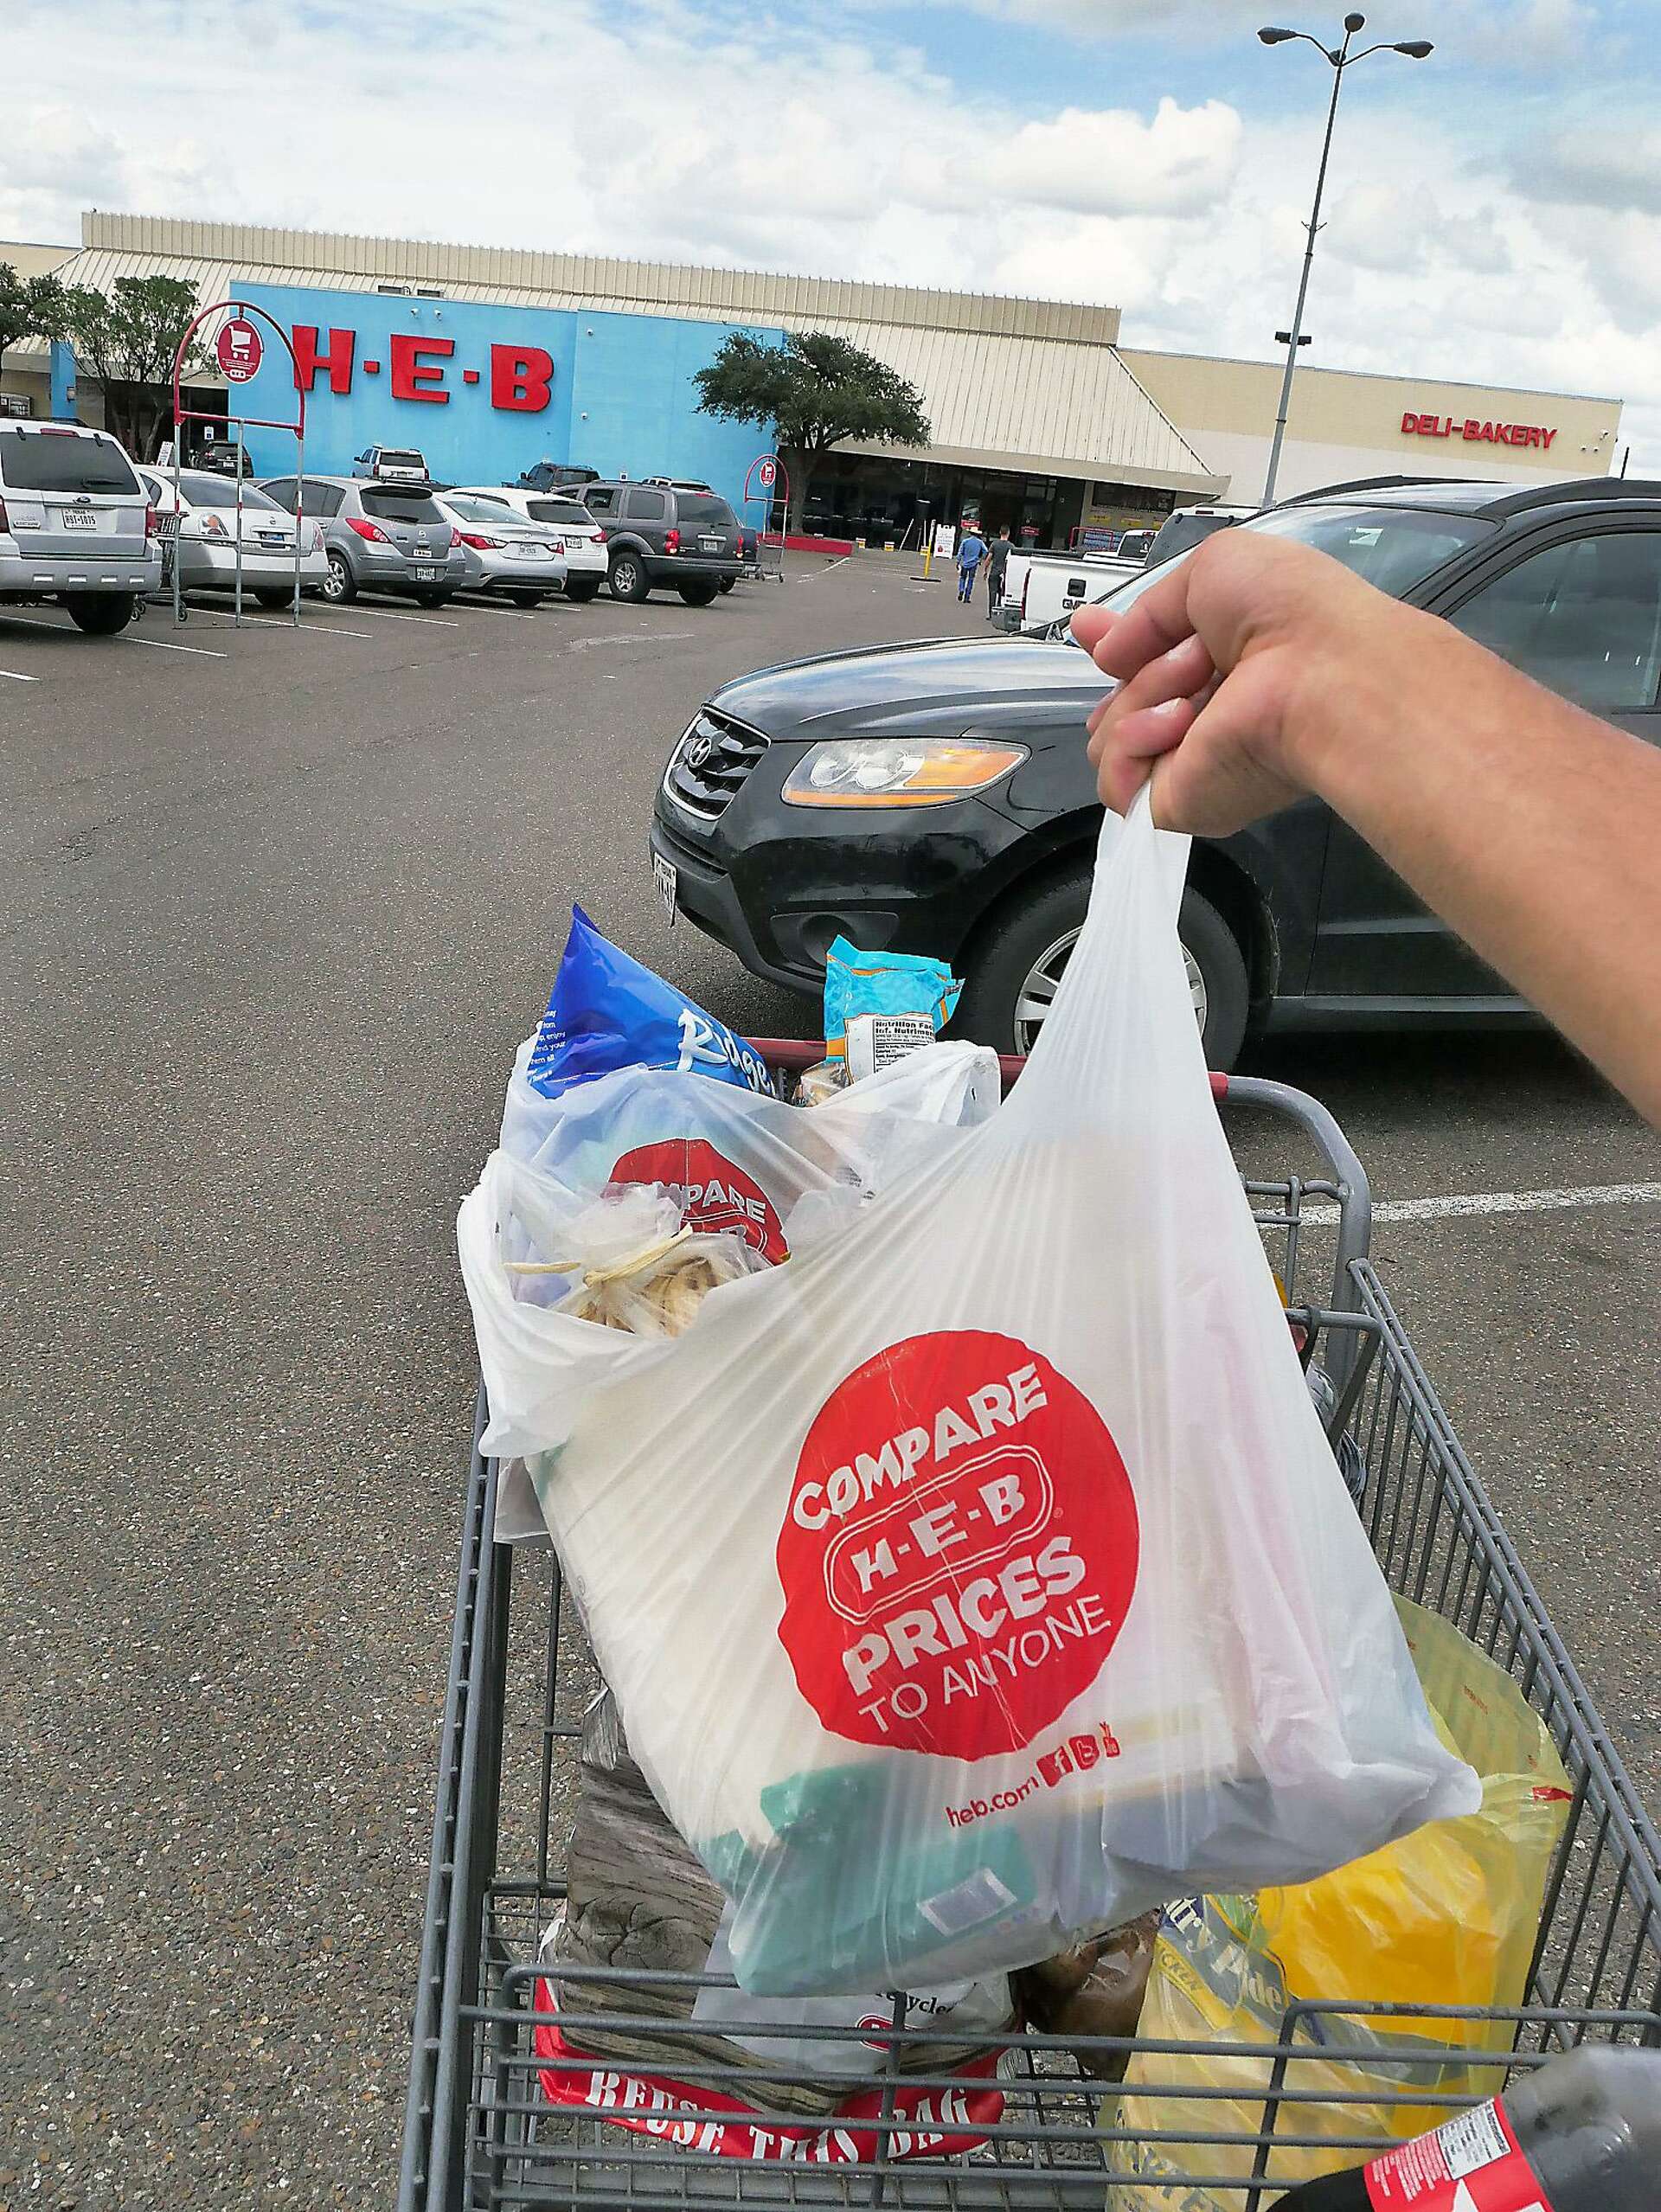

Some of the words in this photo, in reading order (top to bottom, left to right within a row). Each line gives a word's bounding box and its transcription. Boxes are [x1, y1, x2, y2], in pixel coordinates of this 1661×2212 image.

[1401, 412, 1558, 449] DELI-BAKERY
[793, 1362, 1048, 1530] COMPARE
[850, 1474, 1025, 1593] H-E-B
[842, 1536, 1086, 1697] PRICES
[858, 1683, 927, 1733] TO
[942, 1594, 1113, 1705] ANYONE
[946, 1776, 1040, 1828] heb.com
